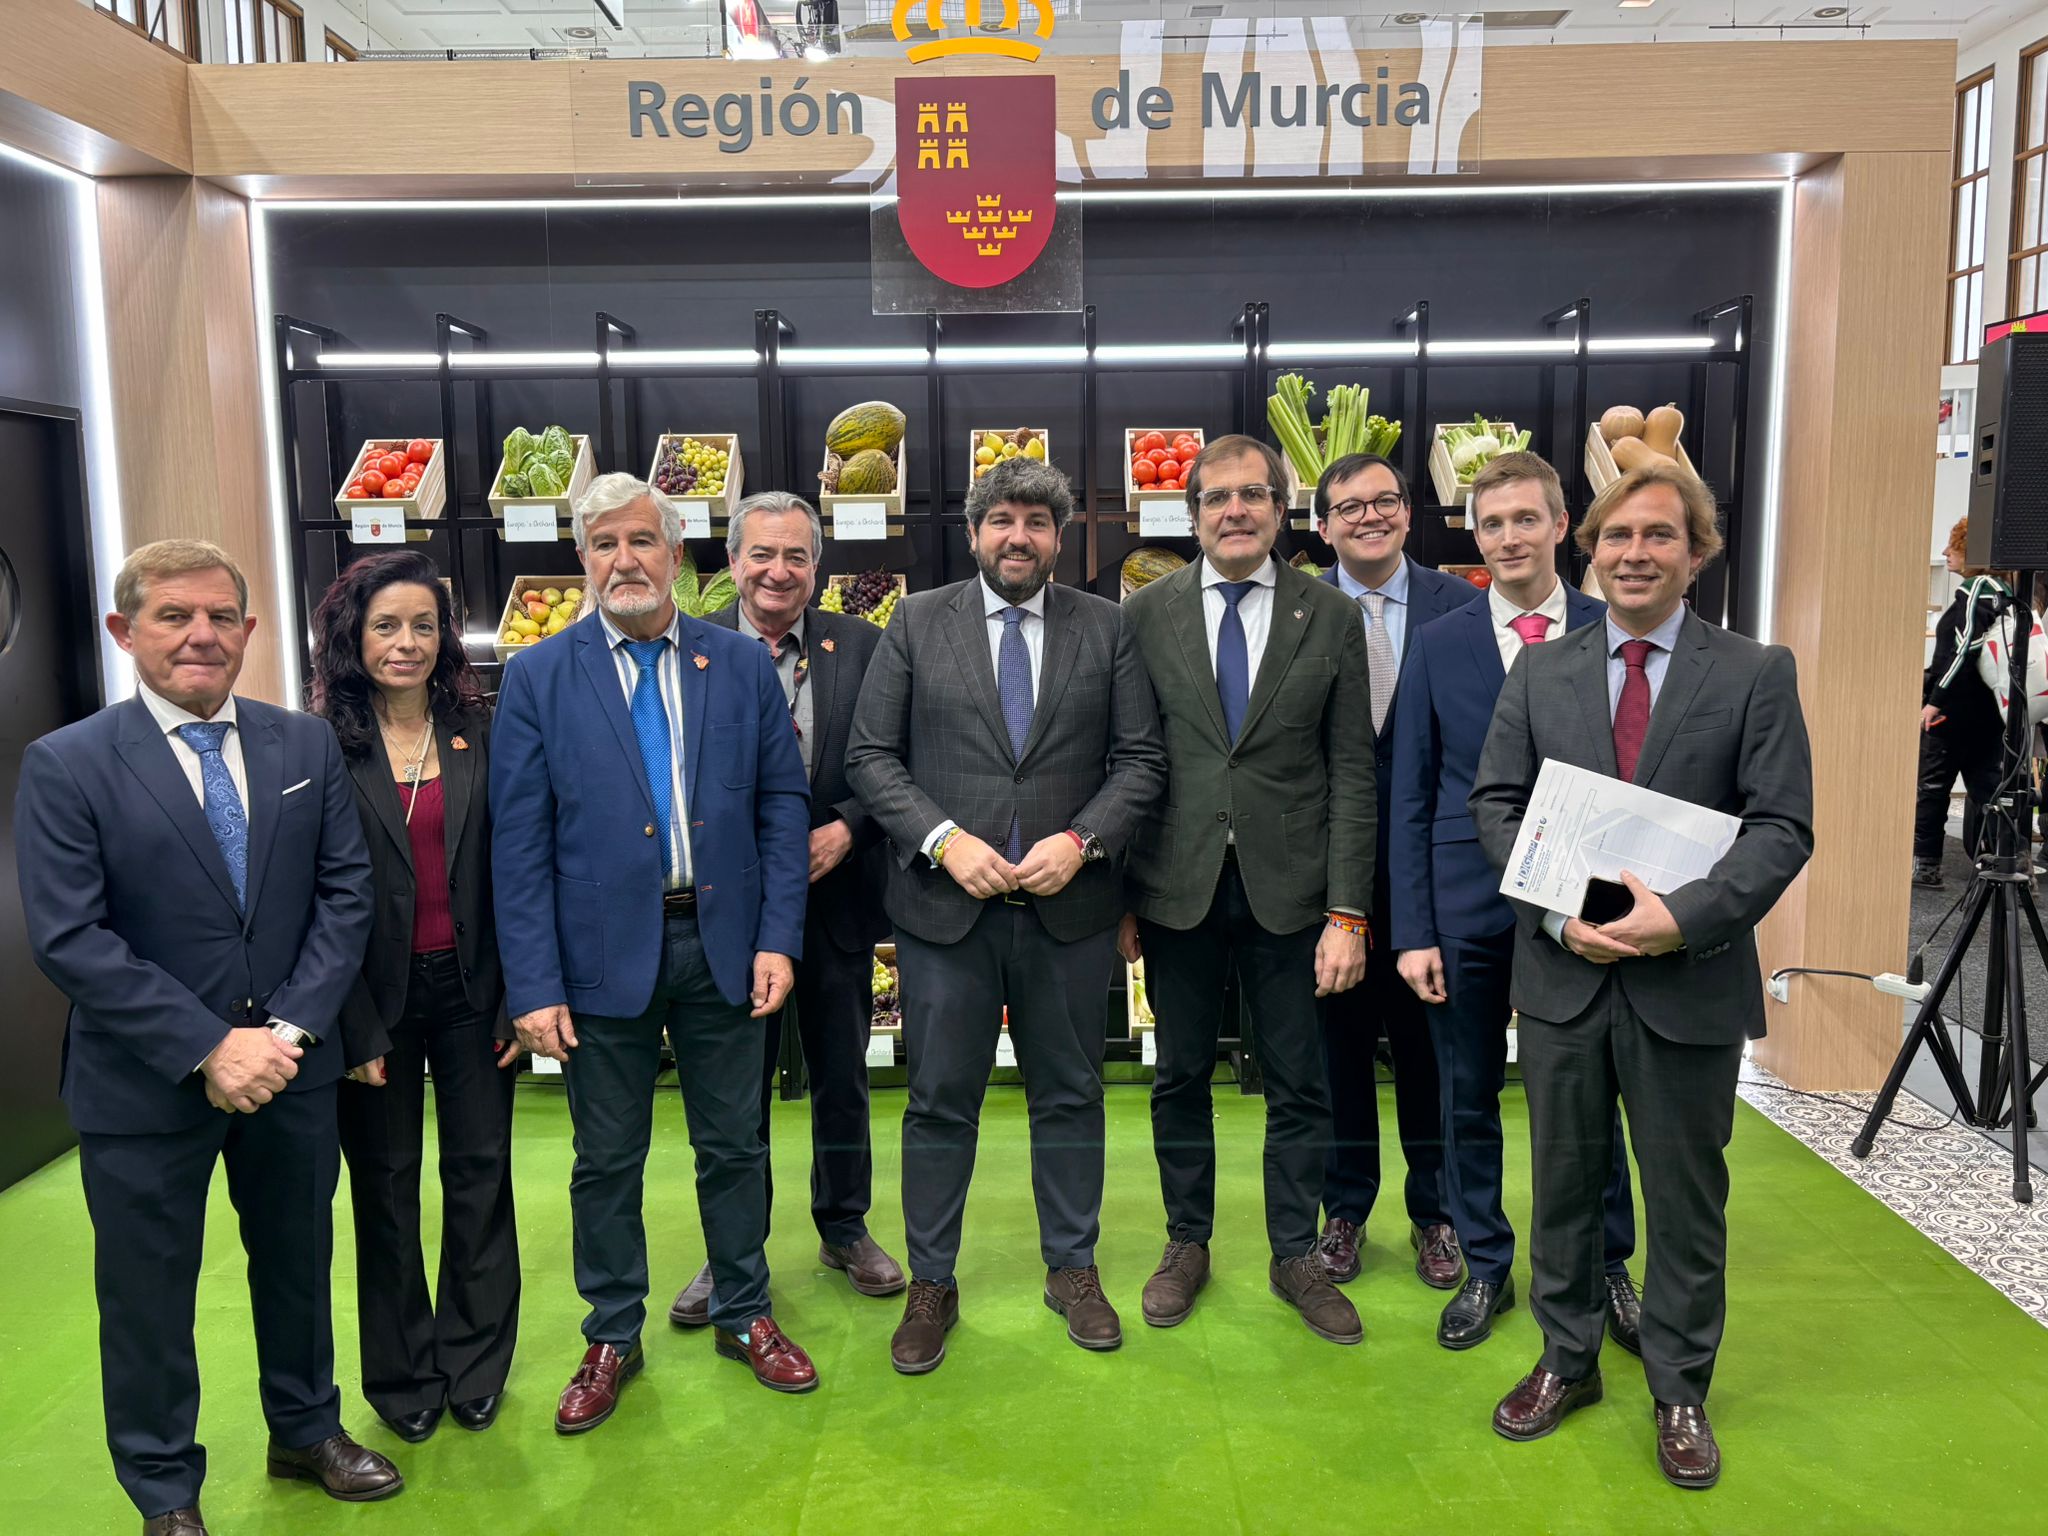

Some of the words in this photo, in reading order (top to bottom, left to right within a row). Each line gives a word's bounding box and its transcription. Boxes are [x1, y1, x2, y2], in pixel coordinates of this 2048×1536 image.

[628, 76, 863, 153] Región
[1091, 69, 1174, 130] de
[1202, 66, 1430, 128] Murcia
